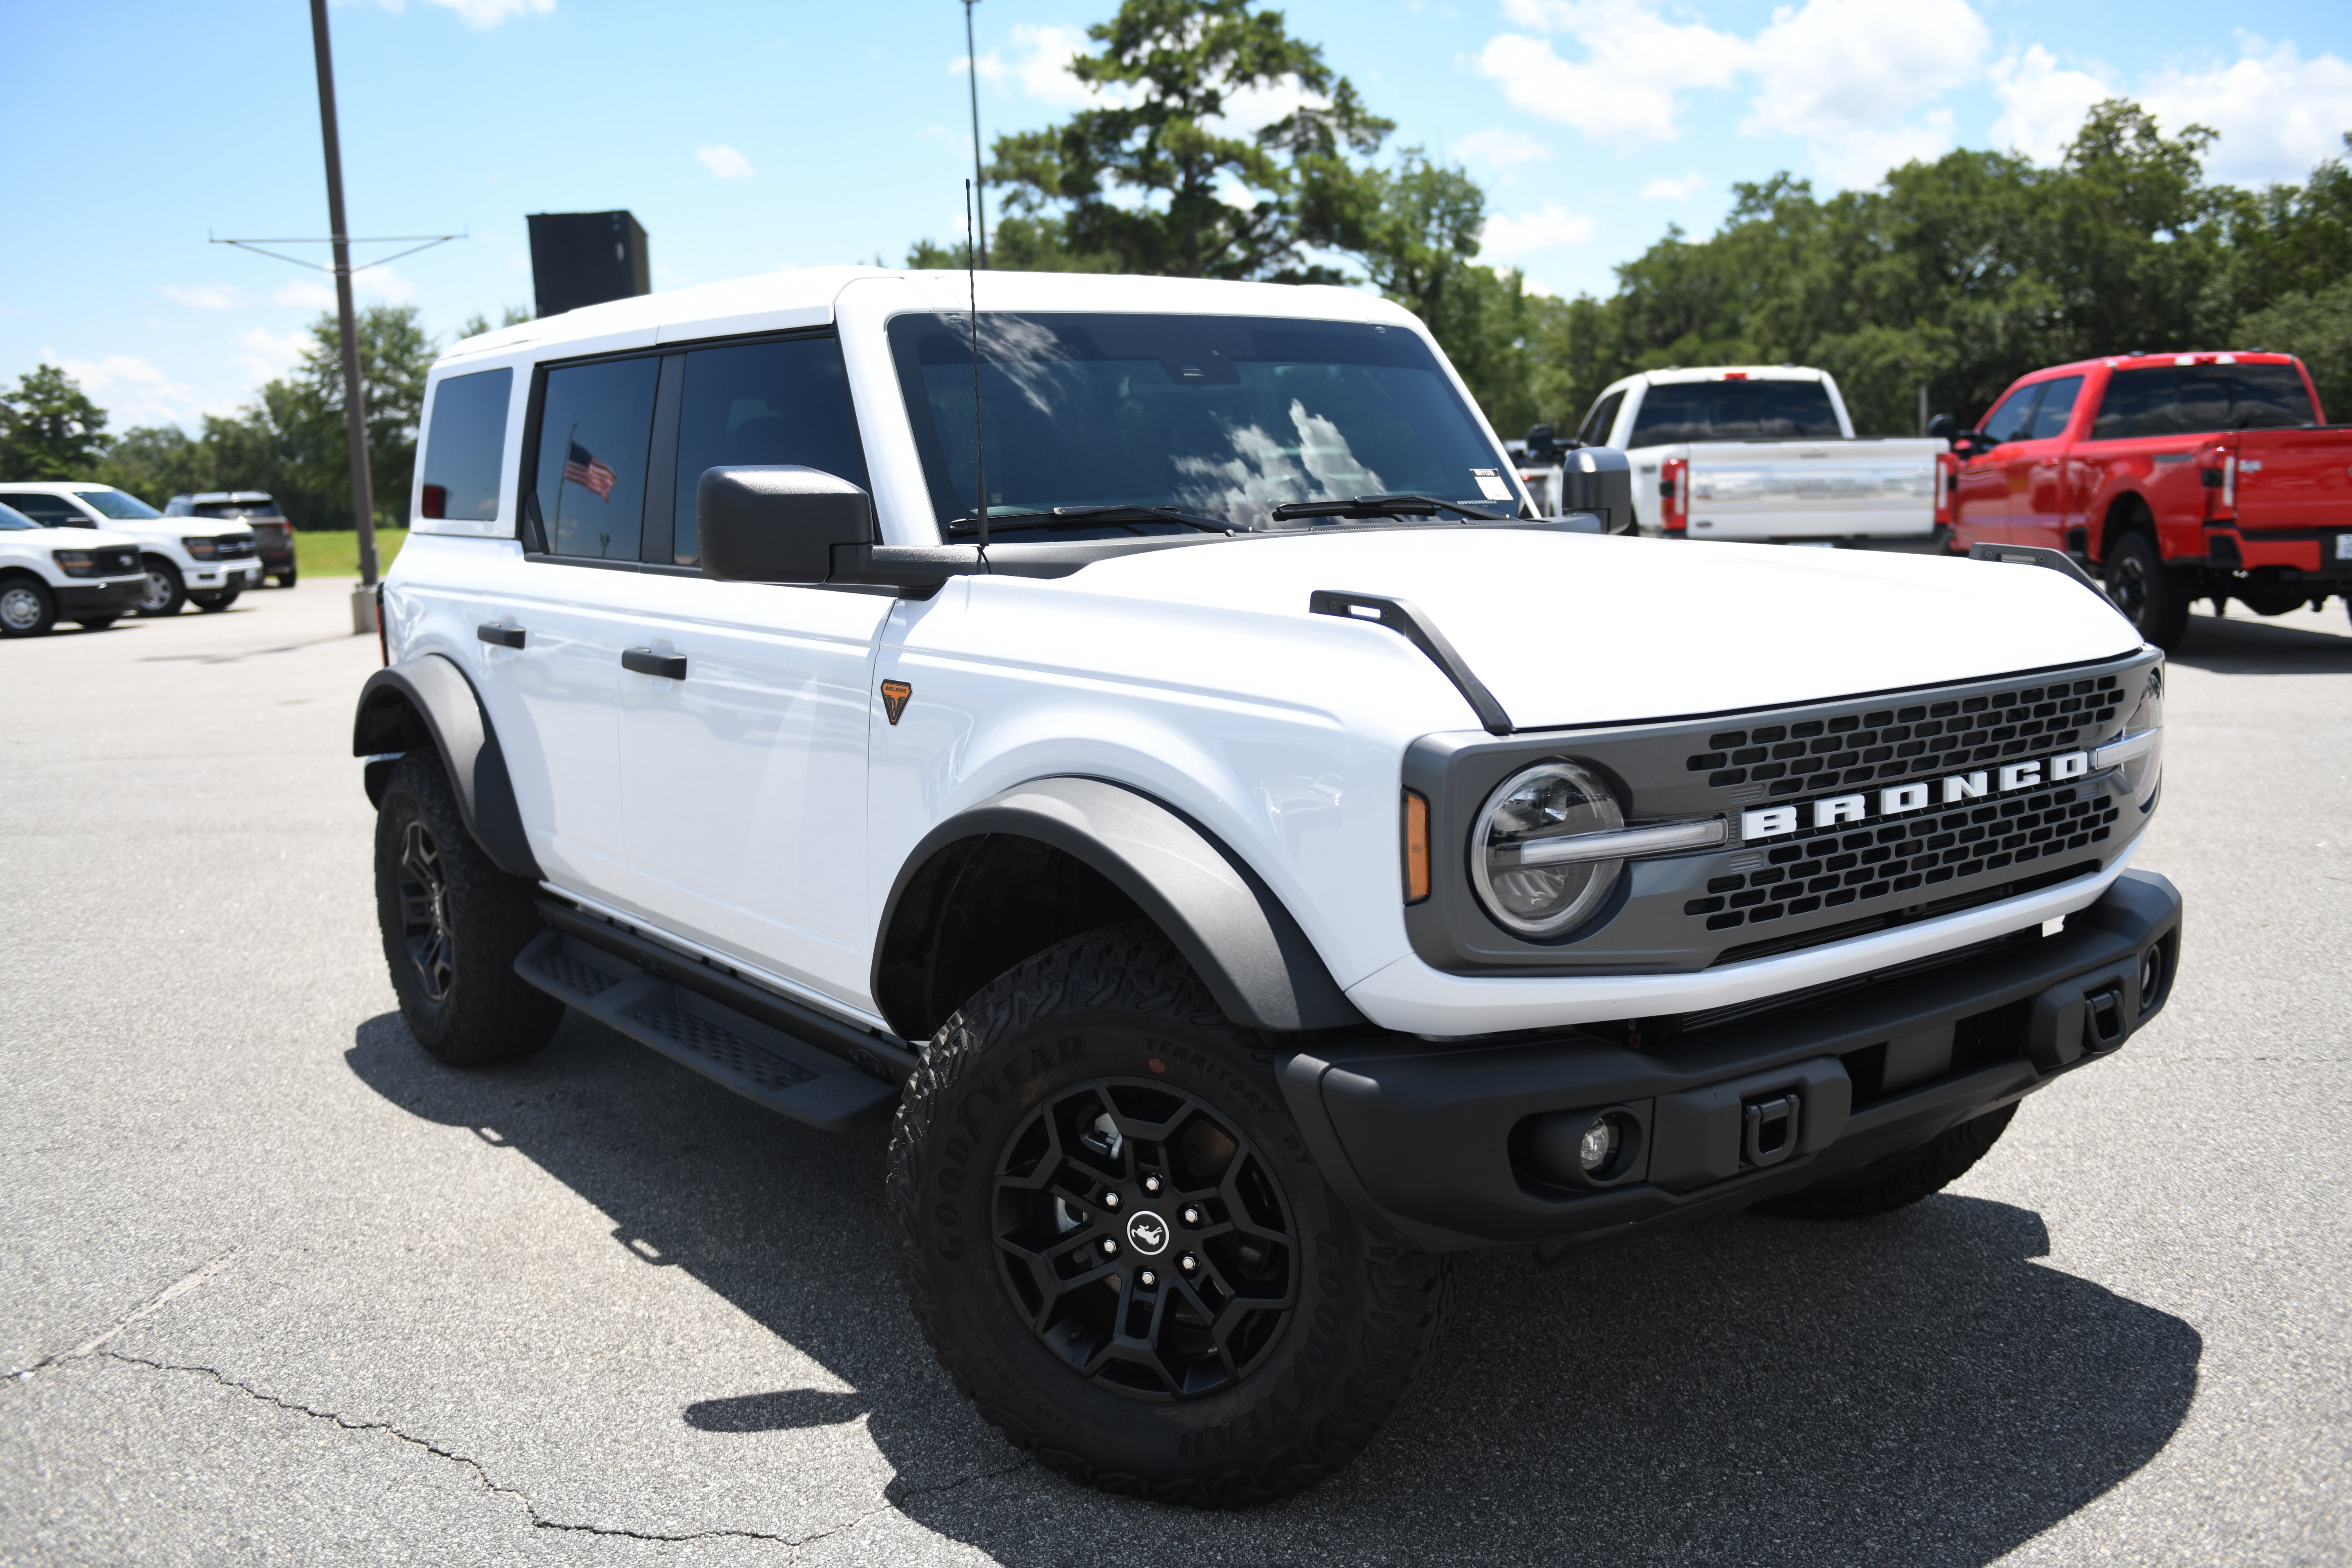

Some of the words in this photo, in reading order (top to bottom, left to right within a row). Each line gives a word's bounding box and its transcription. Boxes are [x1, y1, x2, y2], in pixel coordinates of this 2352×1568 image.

[1742, 751, 2087, 840] BRONCO
[1144, 1036, 1275, 1114] TERRITORY
[934, 1034, 1089, 1263] GOODYEAR
[1283, 1135, 1312, 1165] RT
[985, 1356, 1085, 1439] LT285/70R17
